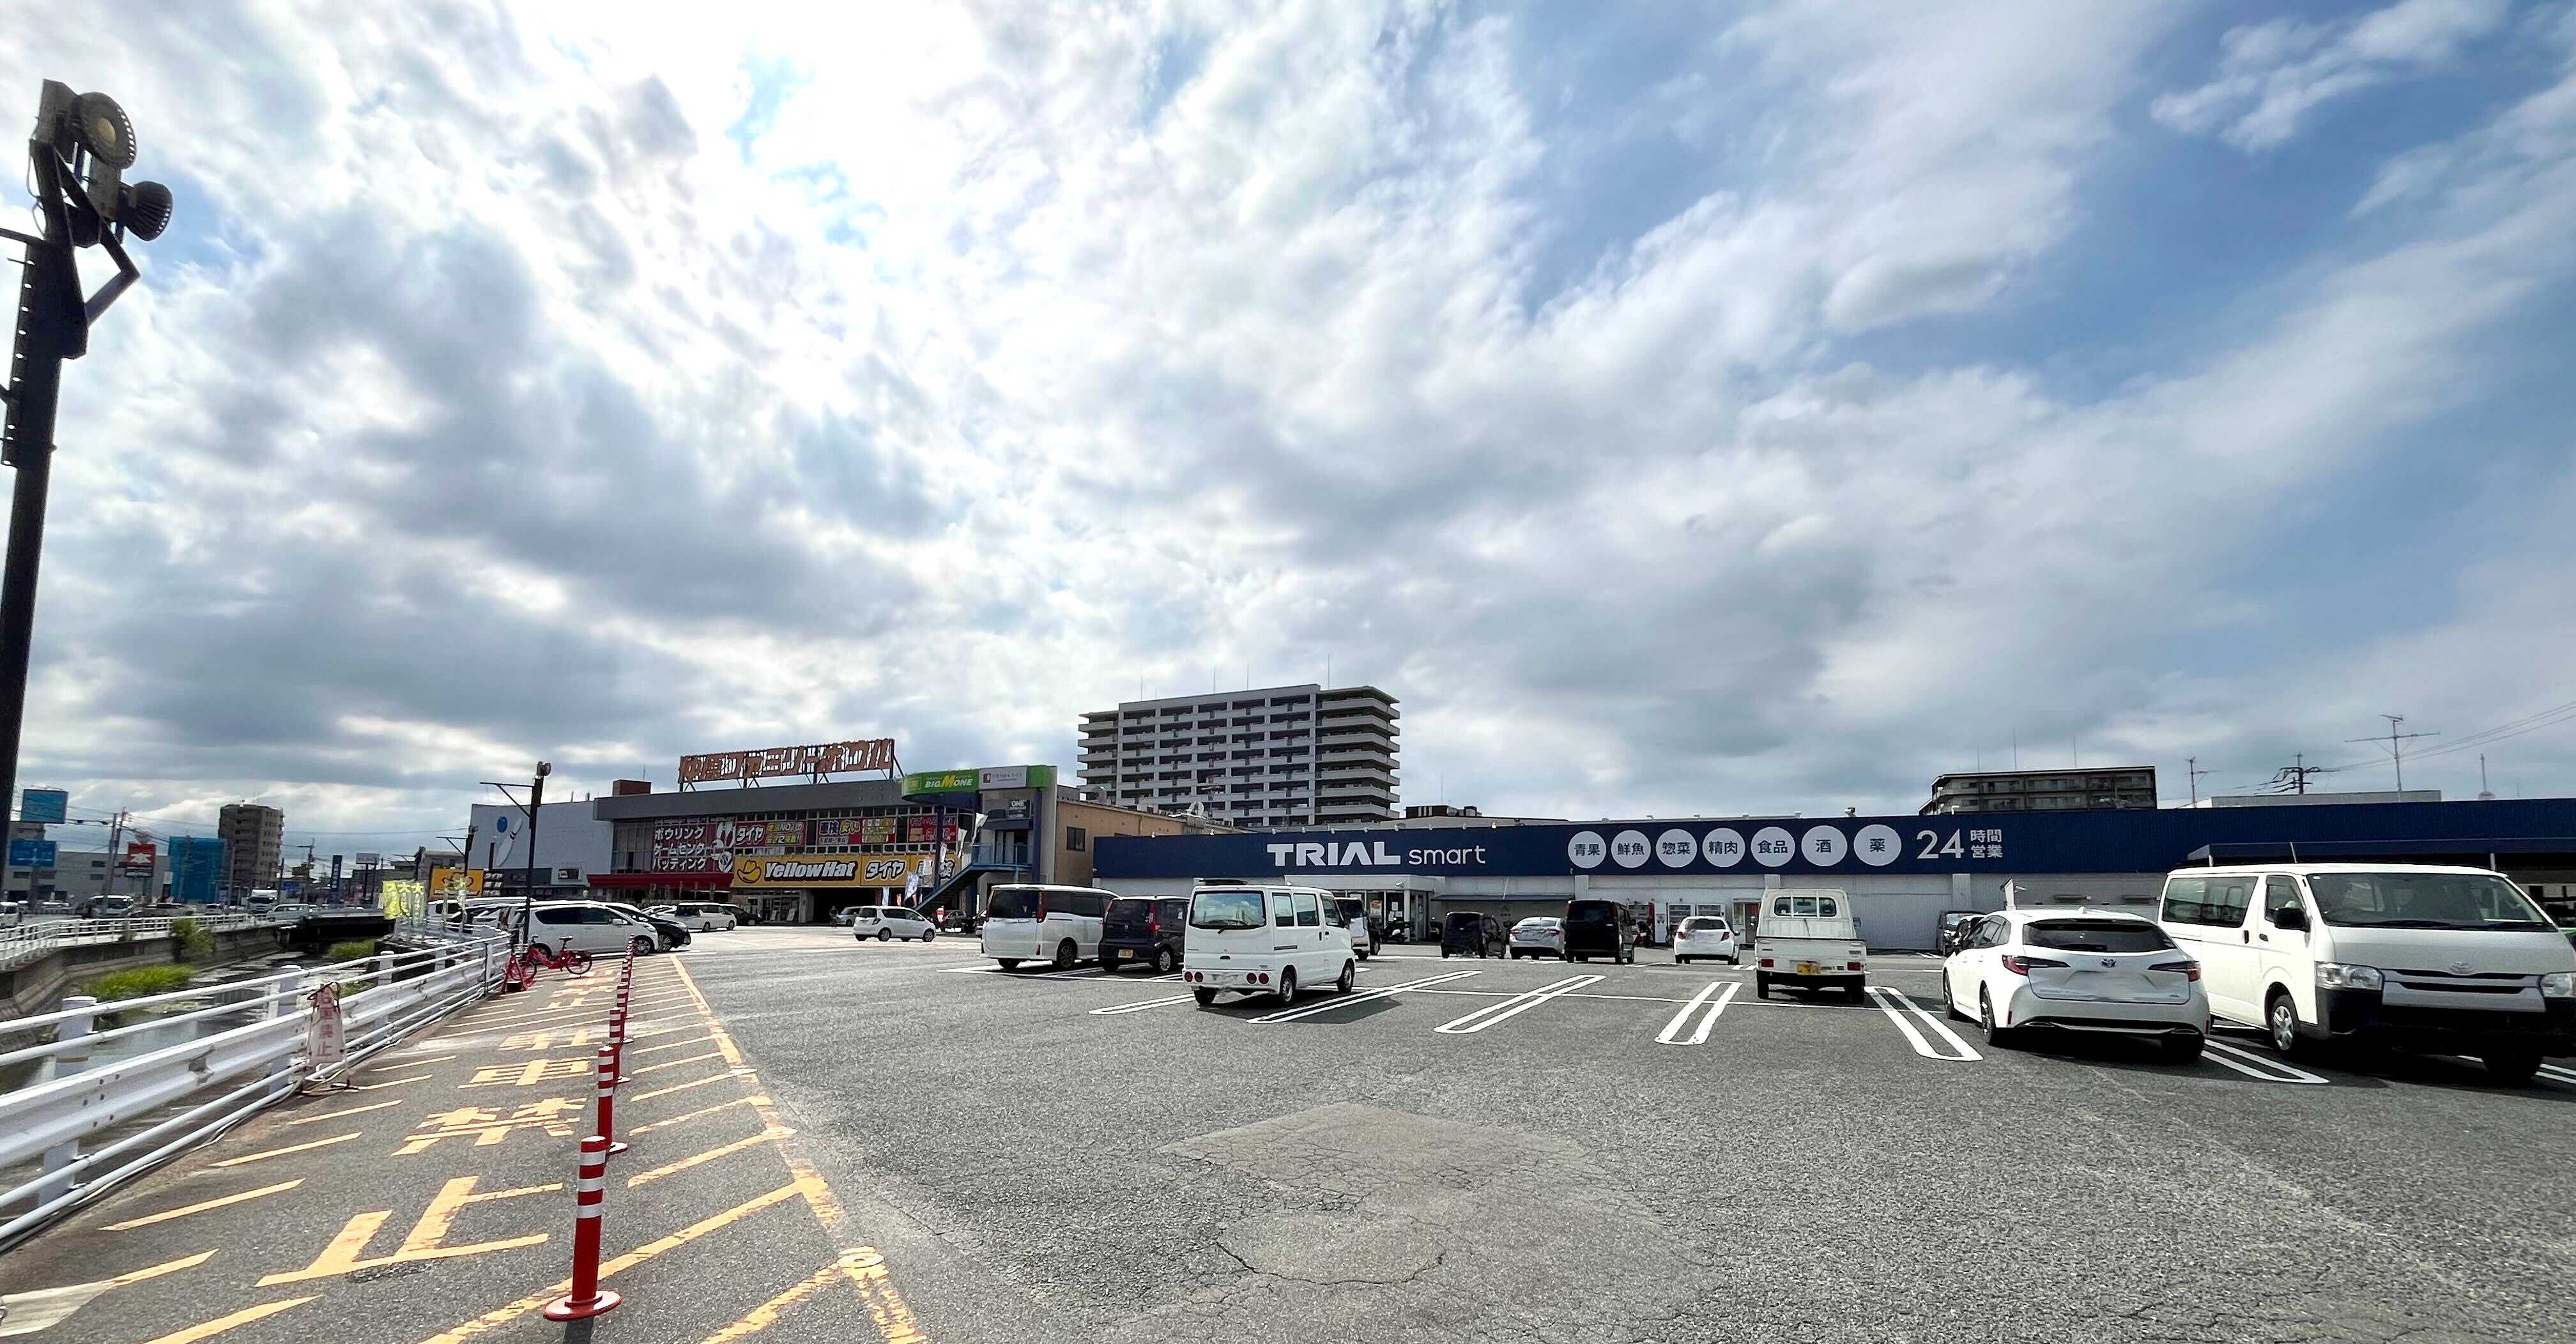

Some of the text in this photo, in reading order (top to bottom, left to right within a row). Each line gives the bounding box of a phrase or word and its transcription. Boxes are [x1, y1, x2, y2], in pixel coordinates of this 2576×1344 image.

[654, 827, 705, 840] ボウリング
[736, 827, 763, 842] タイヤ
[1574, 843, 1600, 856] 青果
[1617, 843, 1645, 856] 鮮魚
[1662, 841, 1691, 855] 惣菜
[1708, 841, 1738, 855] 精肉
[1757, 840, 1788, 854] 食品
[1816, 839, 1832, 853] 酒
[1869, 838, 1885, 853] 薬
[1917, 829, 2002, 859] 24 時間
[1267, 841, 1486, 866] TRIAL smart
[1970, 844, 2004, 859] 営業
[765, 862, 857, 878] YellowHat
[866, 862, 905, 878] タイヤ
